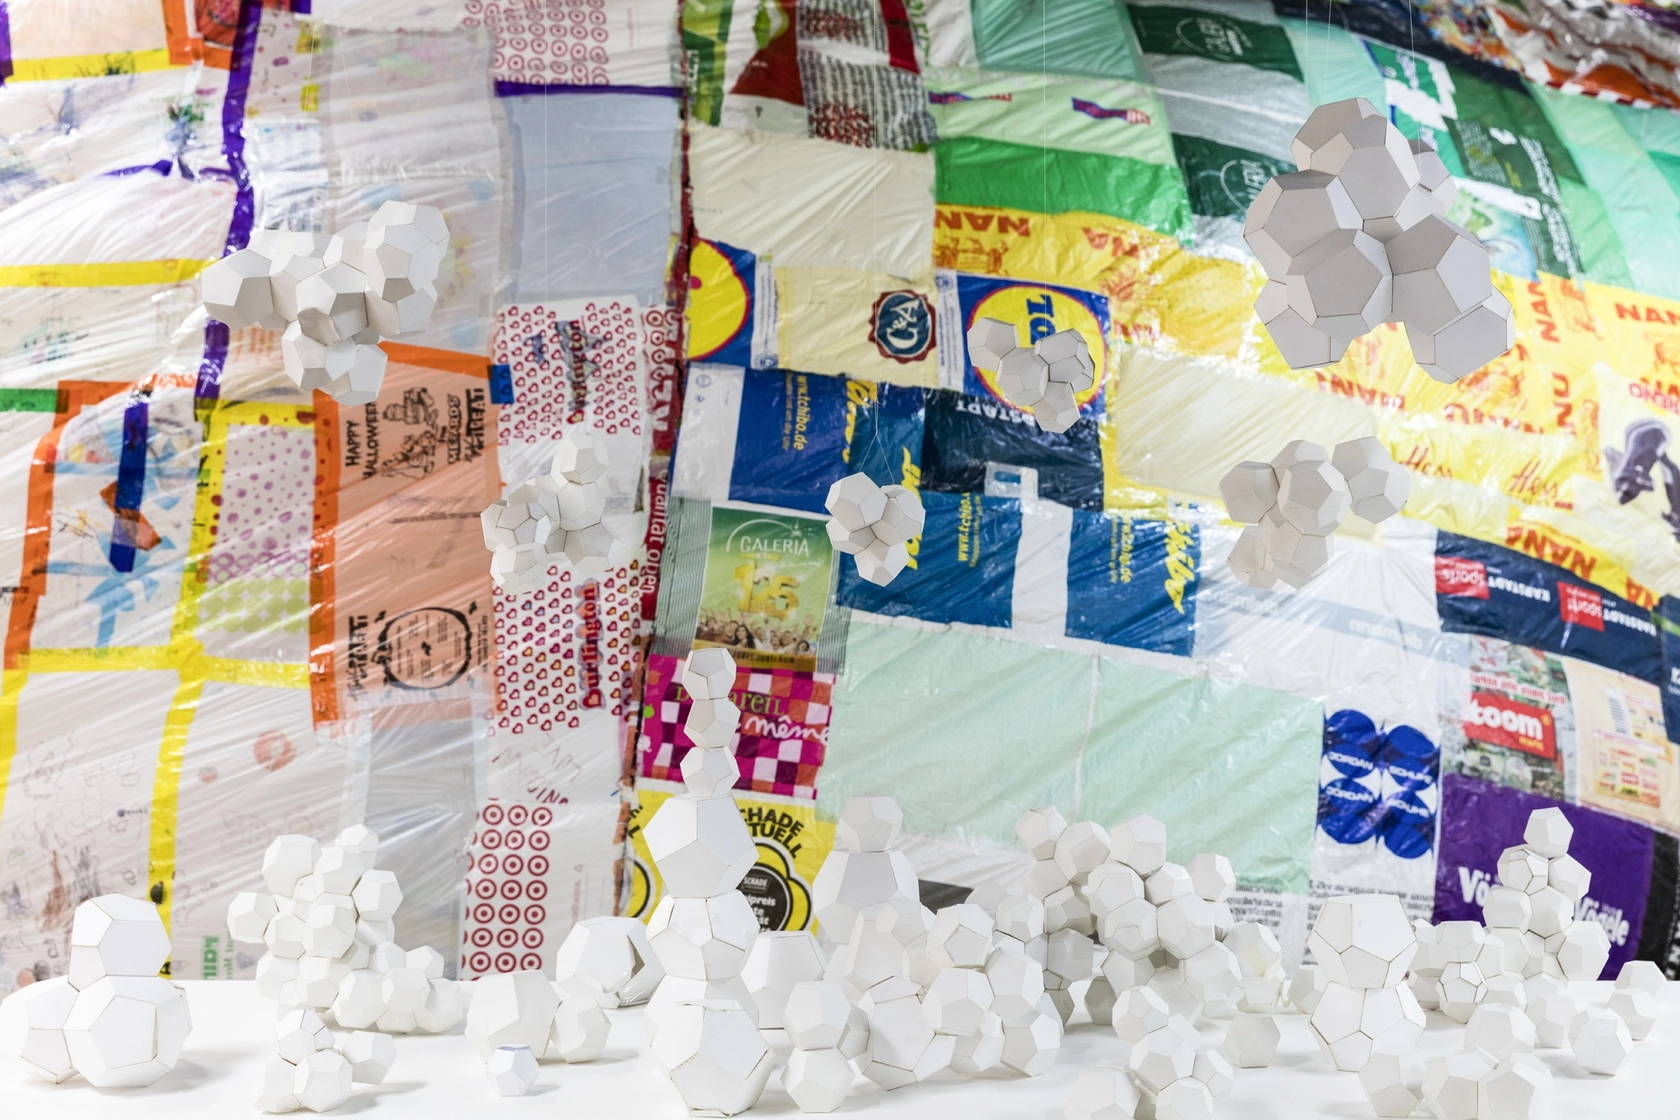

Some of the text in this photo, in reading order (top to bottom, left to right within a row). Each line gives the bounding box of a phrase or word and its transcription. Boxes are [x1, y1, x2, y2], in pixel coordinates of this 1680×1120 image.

[886, 297, 923, 349] C&A
[345, 419, 361, 468] HAPPY
[740, 536, 811, 558] GALERIA
[734, 560, 800, 619] 125
[1467, 699, 1544, 741] toom
